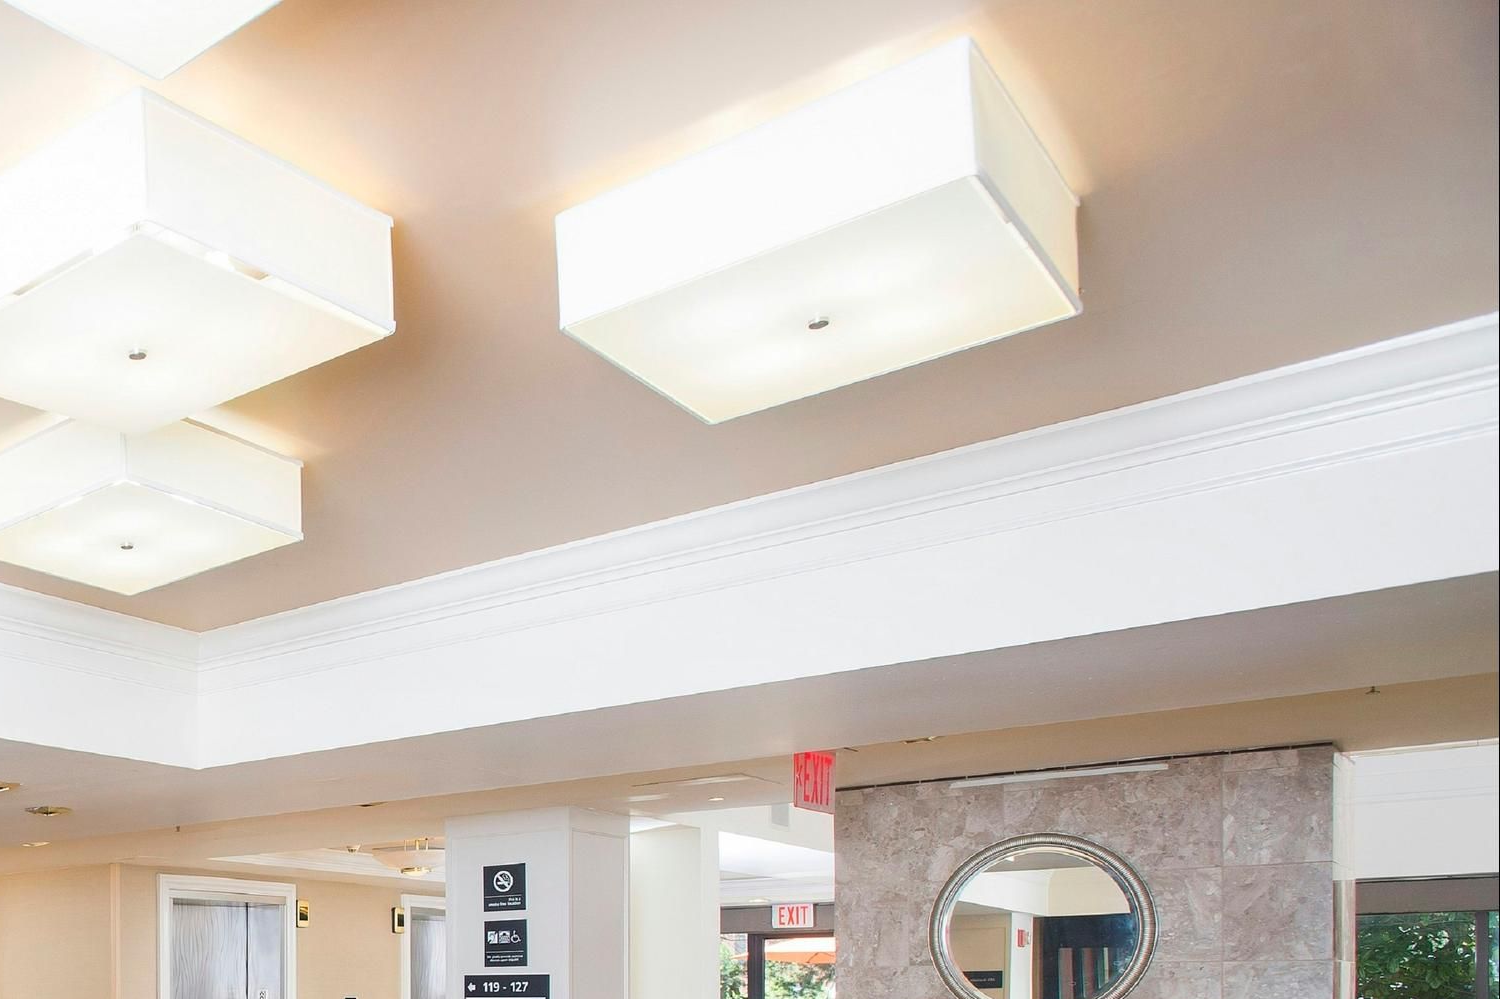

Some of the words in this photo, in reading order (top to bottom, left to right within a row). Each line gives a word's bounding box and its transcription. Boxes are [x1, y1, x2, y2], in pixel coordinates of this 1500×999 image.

[803, 751, 833, 806] EXIT
[779, 905, 809, 925] EXIT
[483, 982, 500, 993] 119
[510, 981, 529, 993] 127
